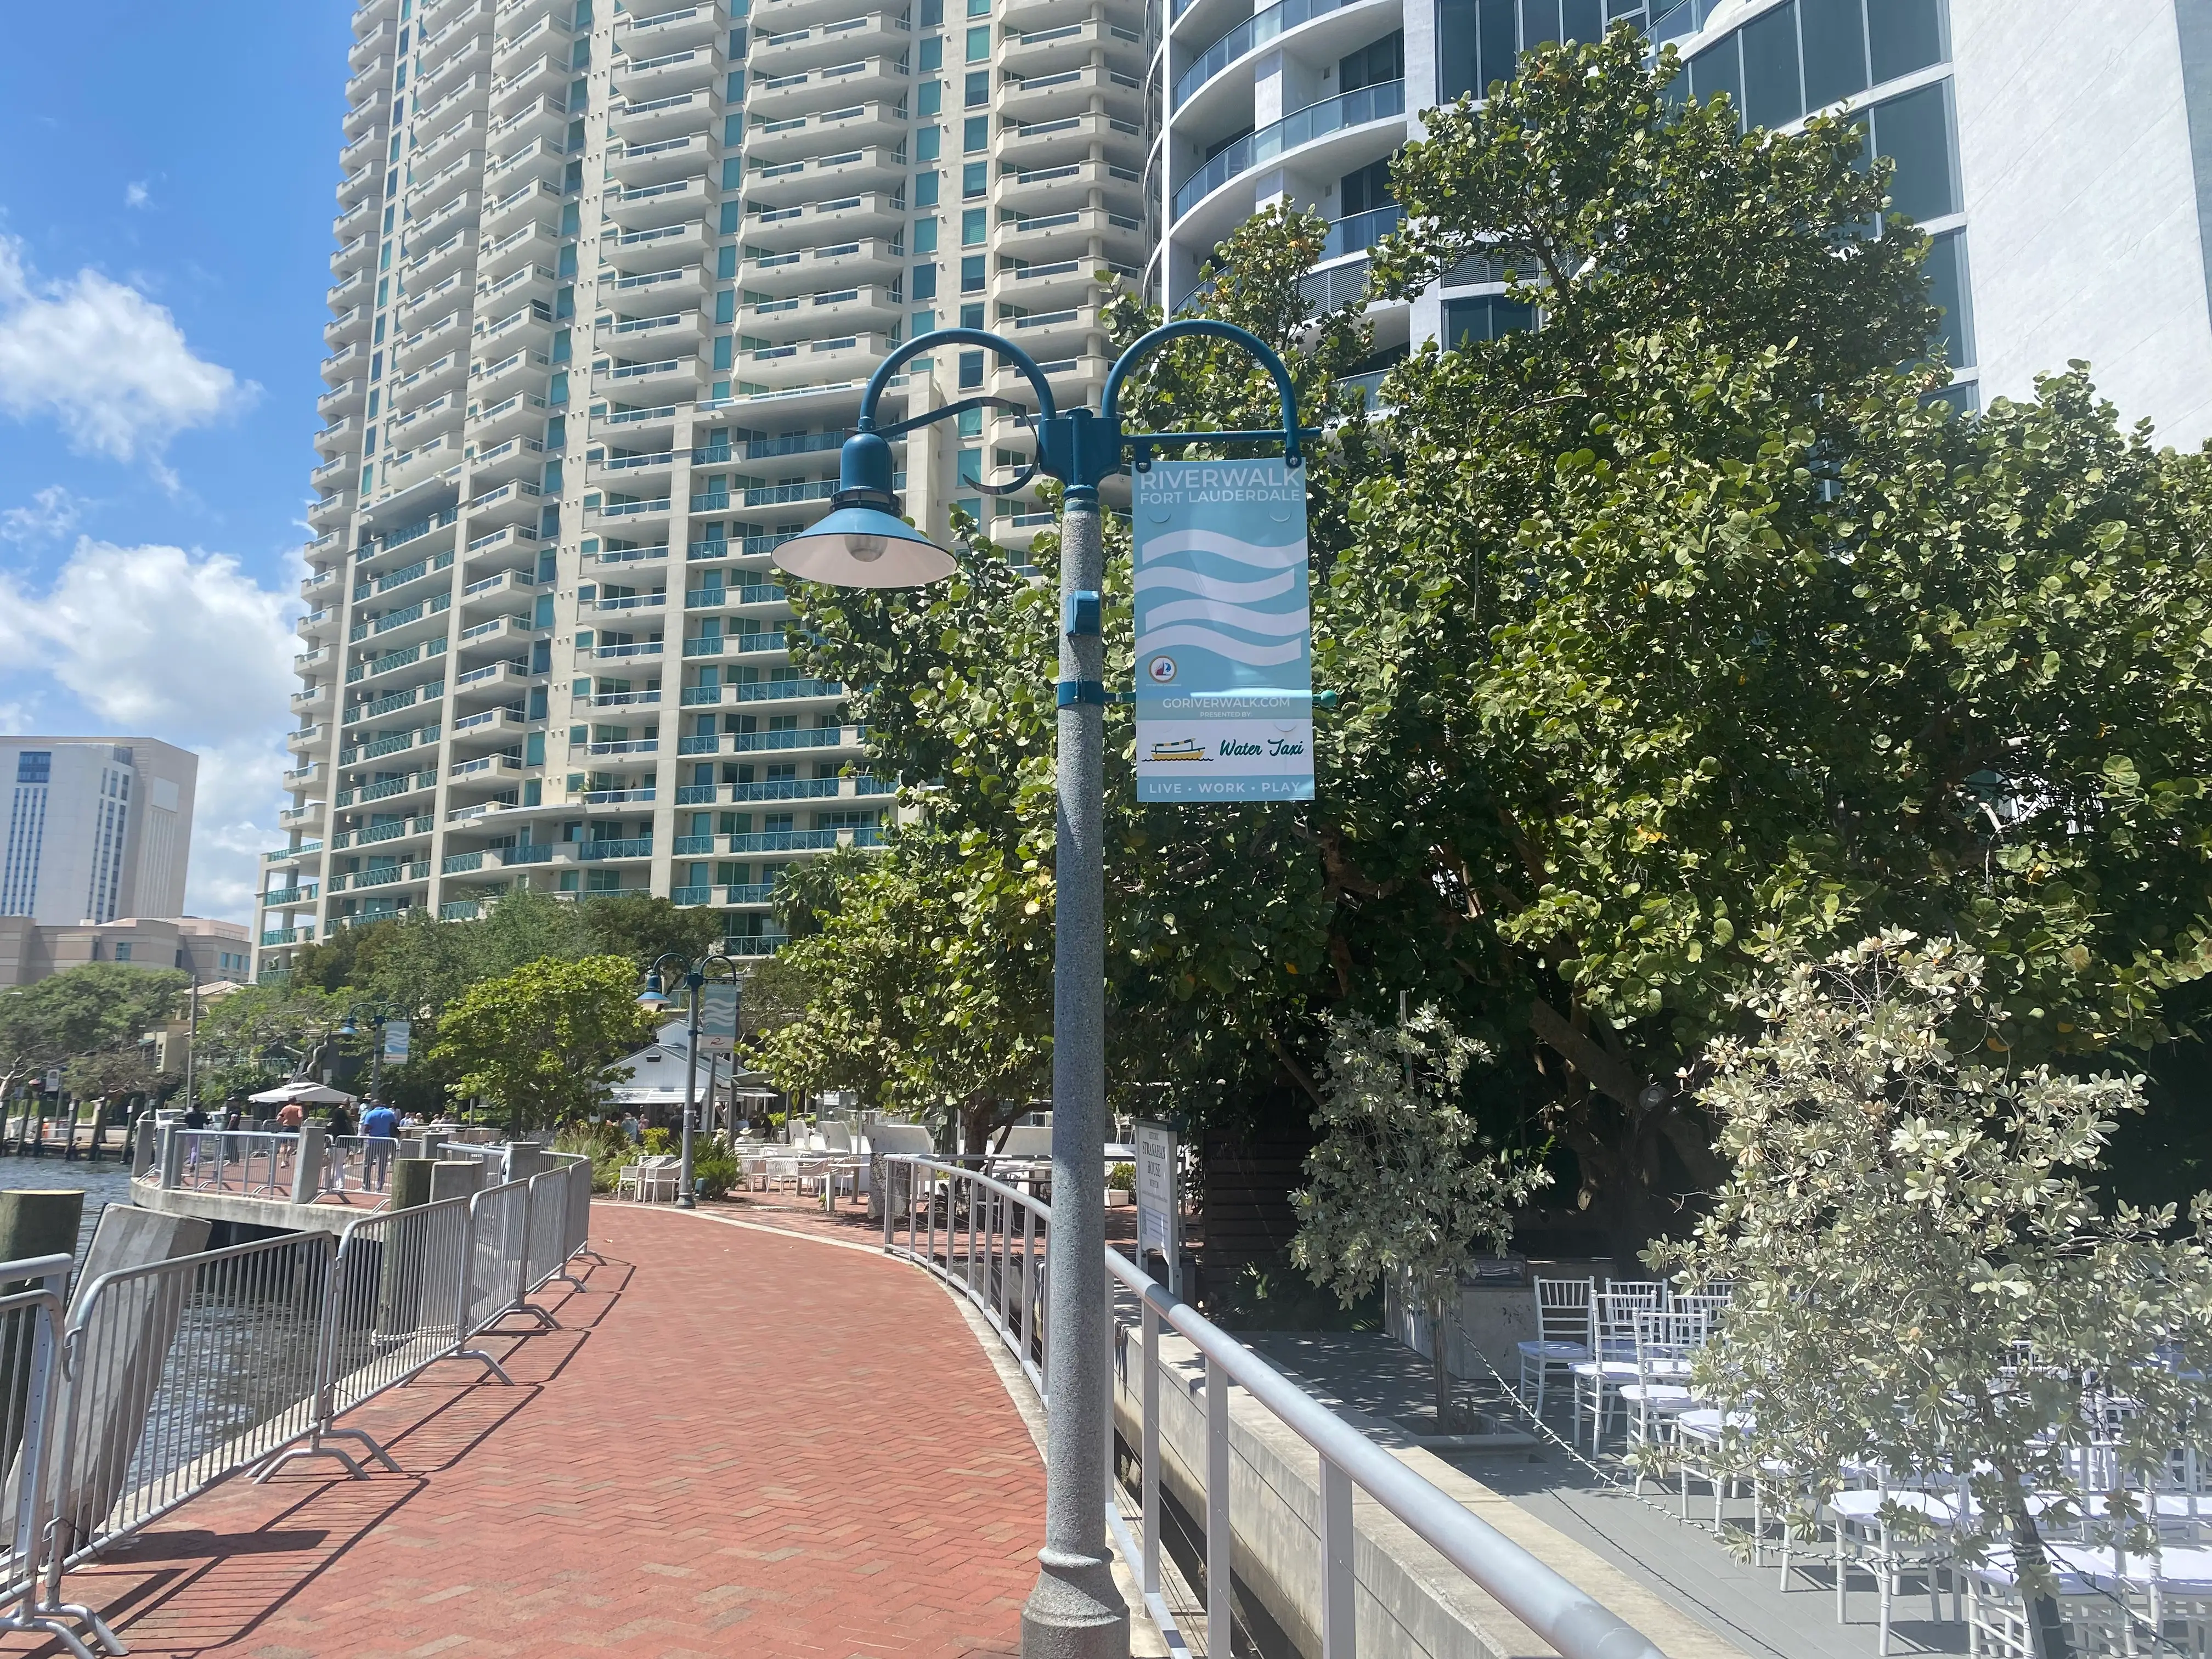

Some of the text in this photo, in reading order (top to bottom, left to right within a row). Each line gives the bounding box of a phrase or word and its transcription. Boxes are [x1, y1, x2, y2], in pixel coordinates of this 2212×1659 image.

[1140, 468, 1300, 490] RIVERWALK
[1139, 489, 1300, 505] FORT LAUDERDALE
[1163, 697, 1290, 708] GORIVERWALK.COM
[1220, 738, 1305, 757] Water Taxi
[1149, 781, 1300, 794] LIVE WORK PLAY
[1142, 1141, 1165, 1159] STRANAHAN
[1147, 1160, 1161, 1177] HOUSE
